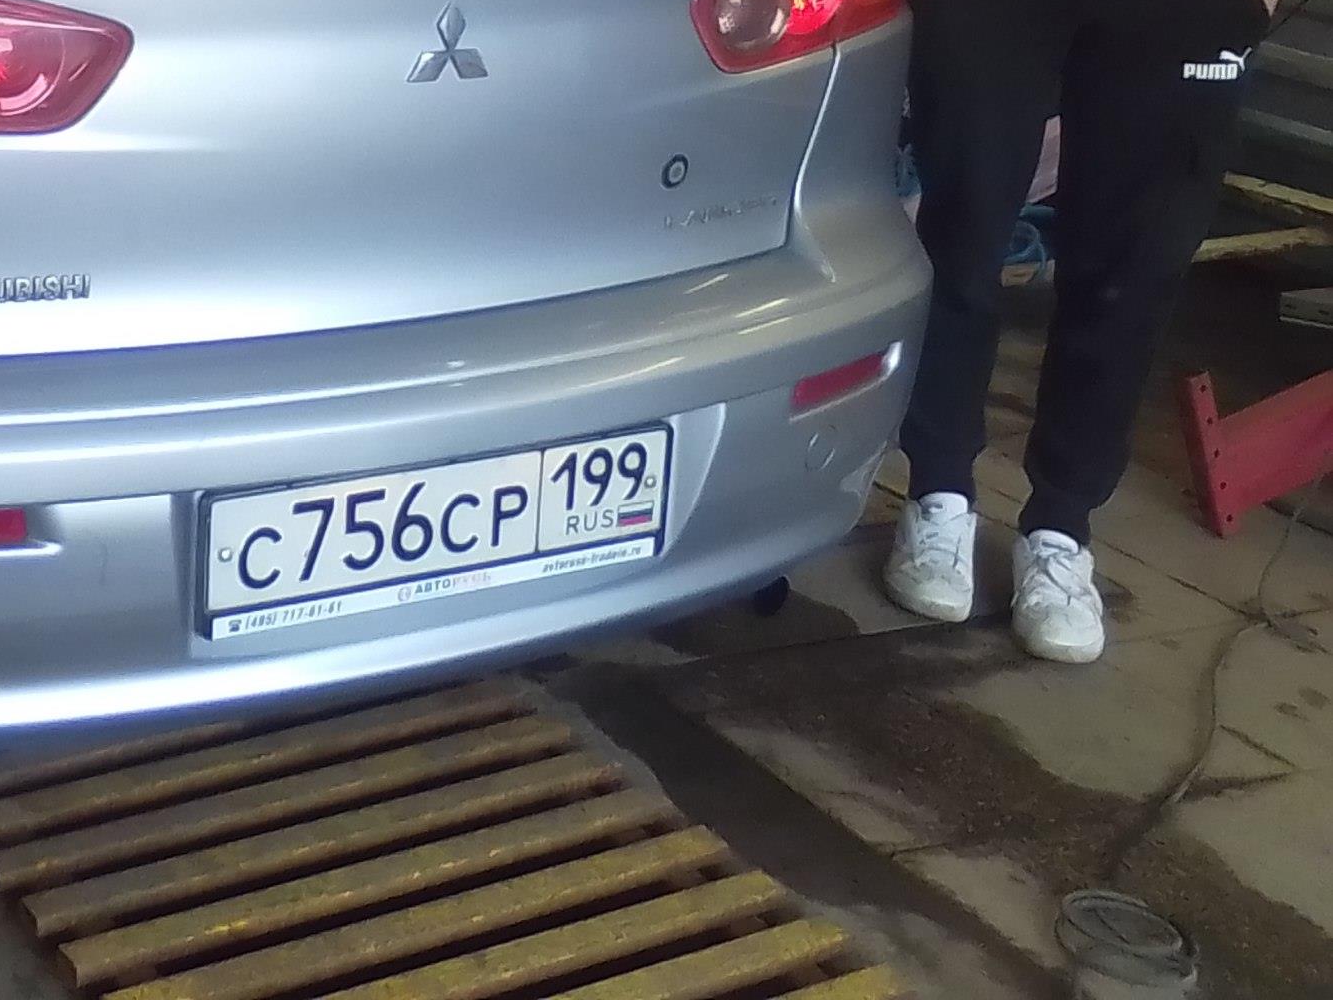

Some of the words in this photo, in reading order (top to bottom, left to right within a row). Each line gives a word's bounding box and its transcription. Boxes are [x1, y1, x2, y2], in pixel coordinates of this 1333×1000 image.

[1183, 63, 1238, 80] PUMA
[237, 481, 528, 590] С756СР
[550, 442, 648, 511] 199
[565, 508, 615, 536] RUS
